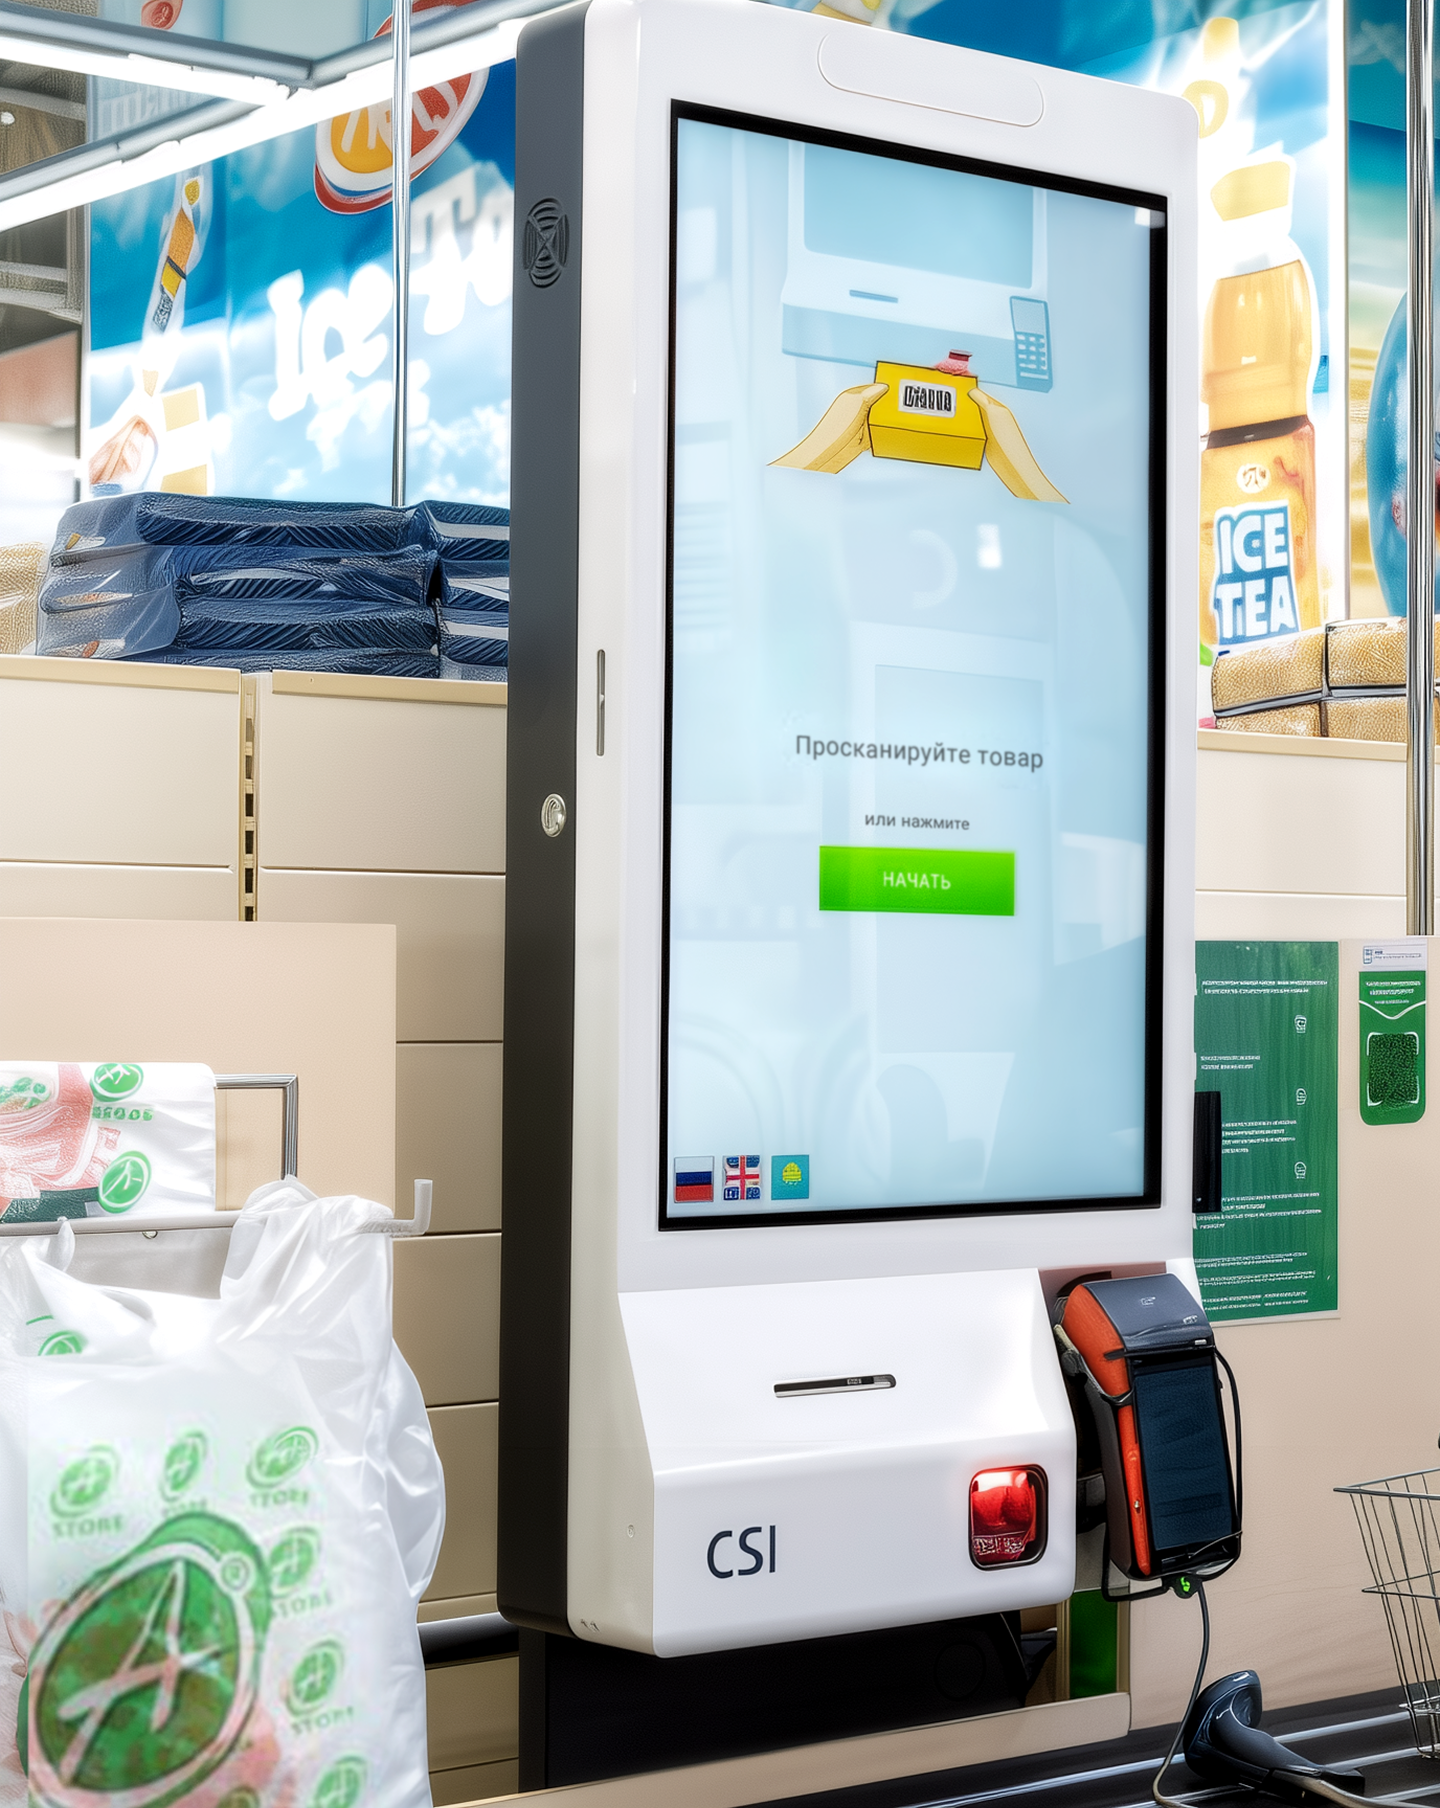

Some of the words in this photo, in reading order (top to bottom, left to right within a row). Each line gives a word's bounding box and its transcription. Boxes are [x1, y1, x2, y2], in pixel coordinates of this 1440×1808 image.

[1219, 512, 1289, 574] ICE
[1215, 575, 1296, 639] TEA
[796, 735, 971, 767] Просканируйте
[977, 748, 1043, 773] товар
[865, 814, 896, 827] или
[901, 815, 970, 831] нажмите
[883, 871, 951, 890] НАЧАТЬ
[707, 1525, 776, 1579] CSI
